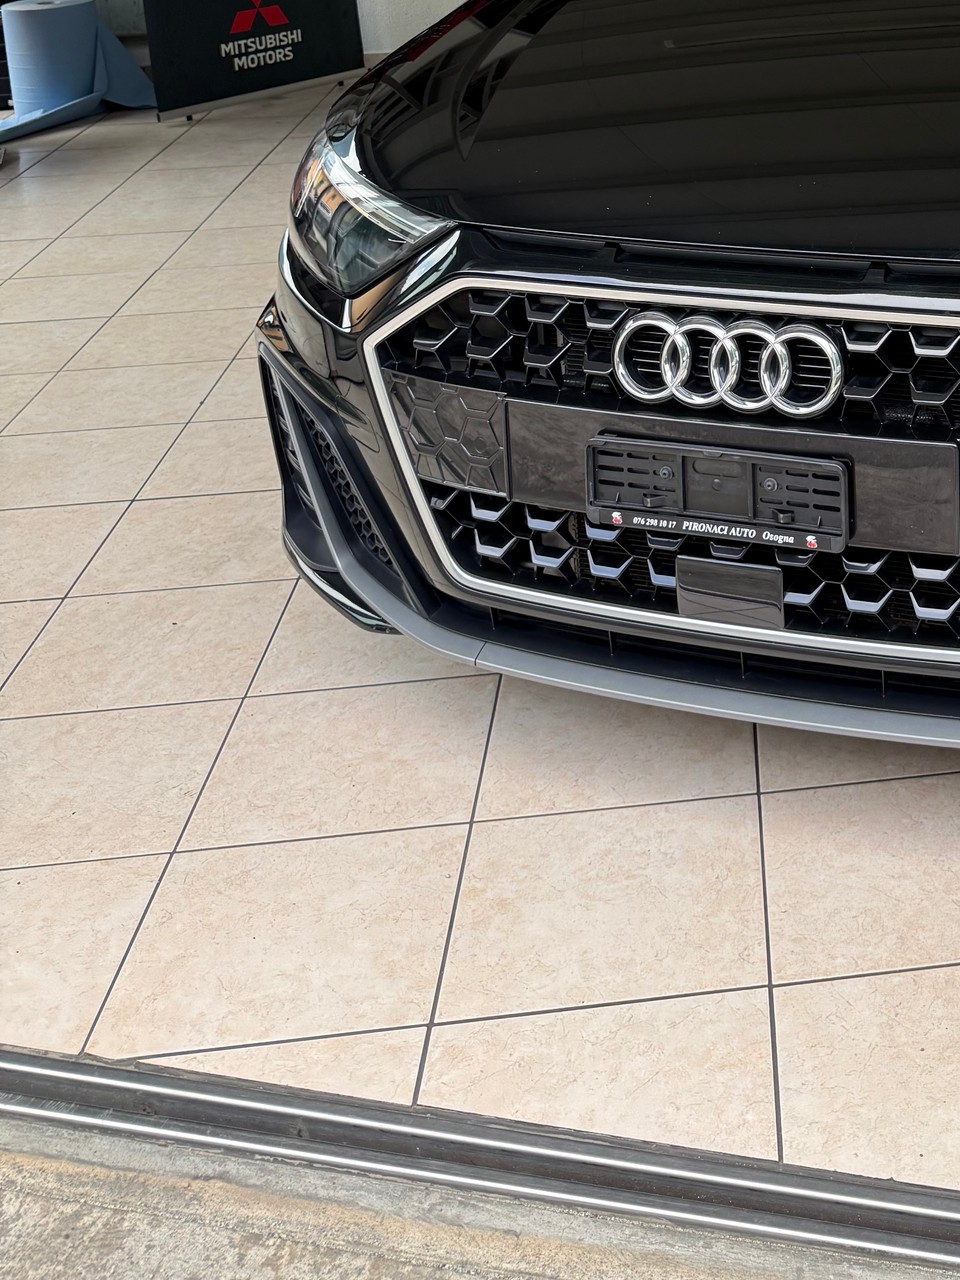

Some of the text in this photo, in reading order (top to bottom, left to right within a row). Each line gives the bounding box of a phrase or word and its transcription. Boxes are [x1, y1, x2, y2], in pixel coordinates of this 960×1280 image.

[220, 28, 303, 58] MITSUBISHI
[233, 46, 295, 72] MOTORS
[633, 517, 646, 526] 076
[659, 519, 668, 528] 10
[668, 521, 677, 529] 17
[682, 521, 728, 536] PIRONACI
[729, 527, 757, 539] AUTO
[762, 531, 795, 544] Osogna
